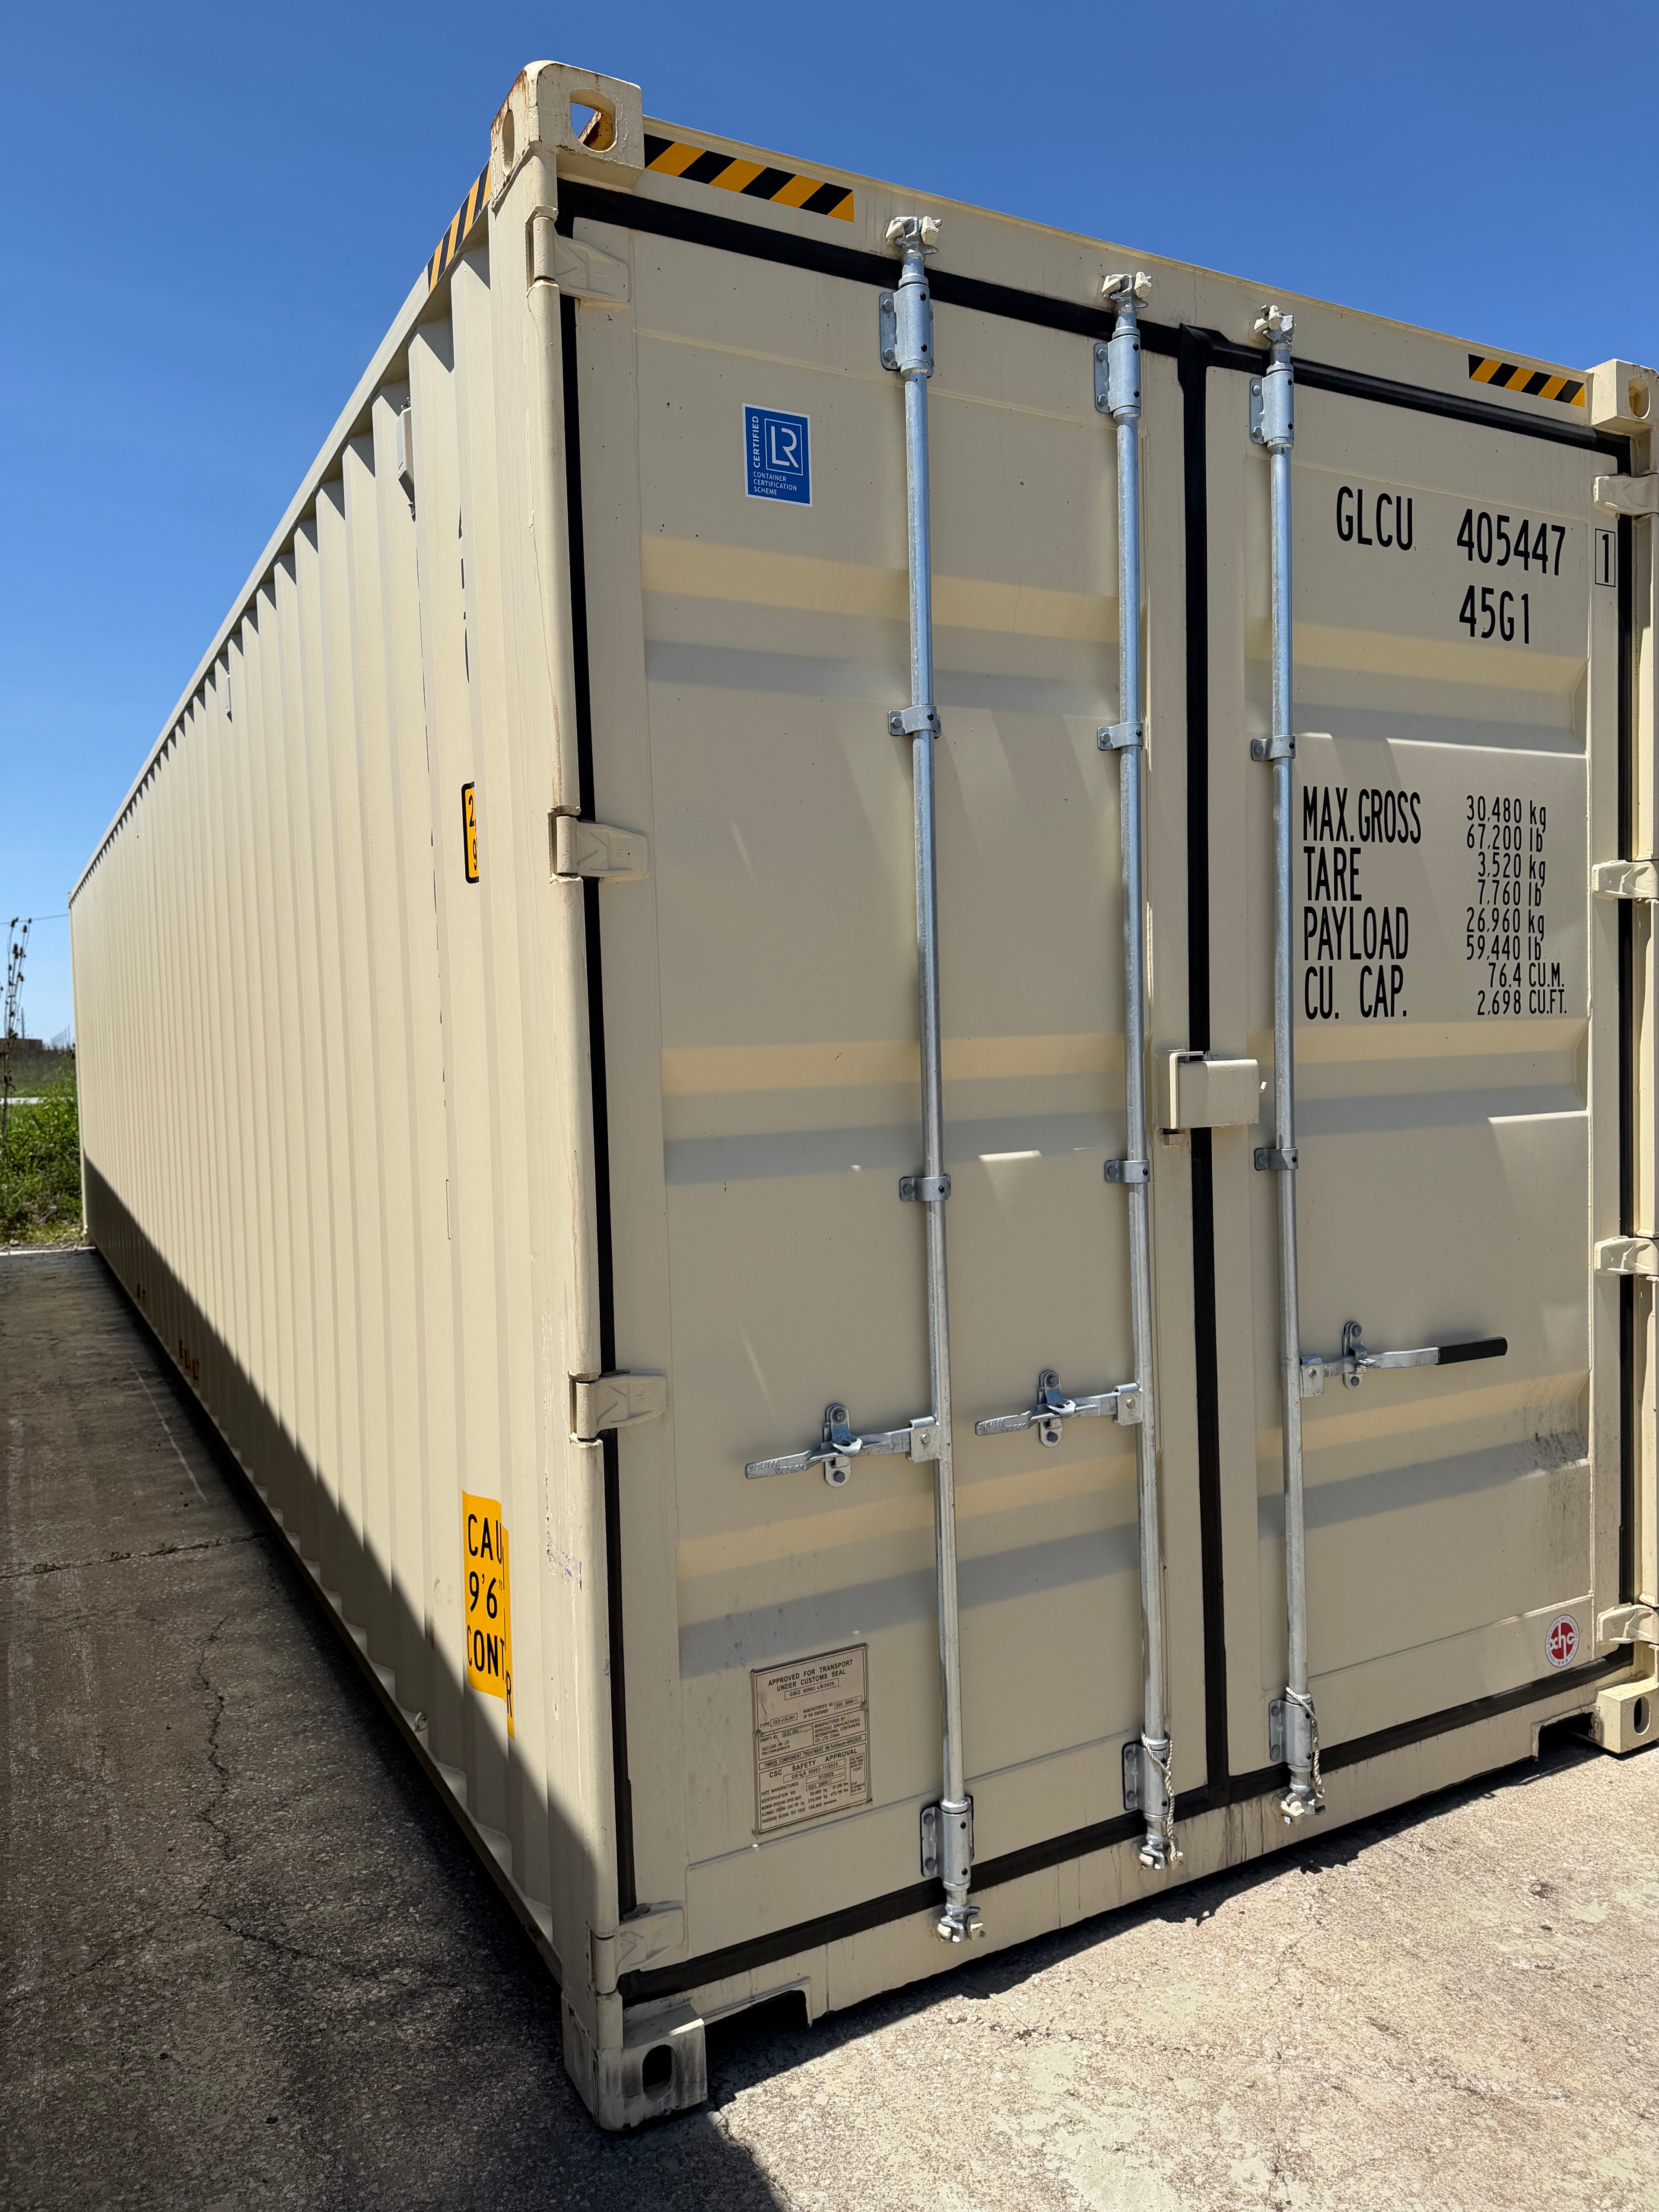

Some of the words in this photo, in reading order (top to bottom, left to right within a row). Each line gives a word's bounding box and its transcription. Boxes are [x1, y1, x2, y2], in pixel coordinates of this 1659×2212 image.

[752, 416, 760, 468] CERTIFIED
[771, 426, 799, 468] LR
[753, 471, 786, 482] CONTAINER
[753, 479, 797, 491] CERTIFICATION
[754, 486, 778, 496] SCHEME
[1336, 486, 1413, 551] GLCU
[1456, 509, 1566, 576] 405447
[1602, 534, 1609, 583] 1
[1459, 585, 1529, 644] 45G1
[1466, 795, 1522, 823] 30,480
[1529, 800, 1547, 834] kg
[1466, 823, 1522, 851] 67,200
[1530, 826, 1544, 852] lb
[1303, 846, 1362, 901] TARE
[1478, 852, 1522, 879] 3,520
[1529, 855, 1546, 888] kg
[1477, 879, 1521, 906] 7,760
[1528, 881, 1542, 906] lb
[1303, 906, 1408, 961] PAYLOAD
[1466, 907, 1521, 934] 26,960
[1528, 909, 1545, 942] kg
[1466, 934, 1521, 960] 59,440
[1528, 936, 1541, 961] lb
[1304, 966, 1339, 1020] CU.
[1360, 965, 1408, 1018] CAP.
[1488, 962, 1522, 988] 76.4
[1528, 962, 1565, 988] CU.M.
[1477, 989, 1522, 1016] 2,698
[1529, 989, 1567, 1014] CU.FT.
[467, 1513, 503, 1565] CAU
[768, 1673, 799, 1686] APPROVED
[820, 1659, 852, 1672] TRANSPORT
[777, 1681, 796, 1691] UNDER
[801, 1673, 827, 1685] CUSTOMS
[832, 1669, 845, 1677] SEAL
[815, 1718, 839, 1728] MANUFACTURED
[815, 1729, 838, 1738] INTERNATIONAL
[841, 1723, 860, 1731] CONTAINERS
[769, 1770, 782, 1778] CSC
[792, 1760, 816, 1771] SAFETY
[825, 1748, 857, 1762] APPROVAL
[779, 1754, 801, 1763] COMPONENT
[803, 1747, 823, 1756] TREATMENT
[761, 1792, 788, 1803] IDENTIFICATION
[772, 1782, 798, 1792] MANUFACTURED
